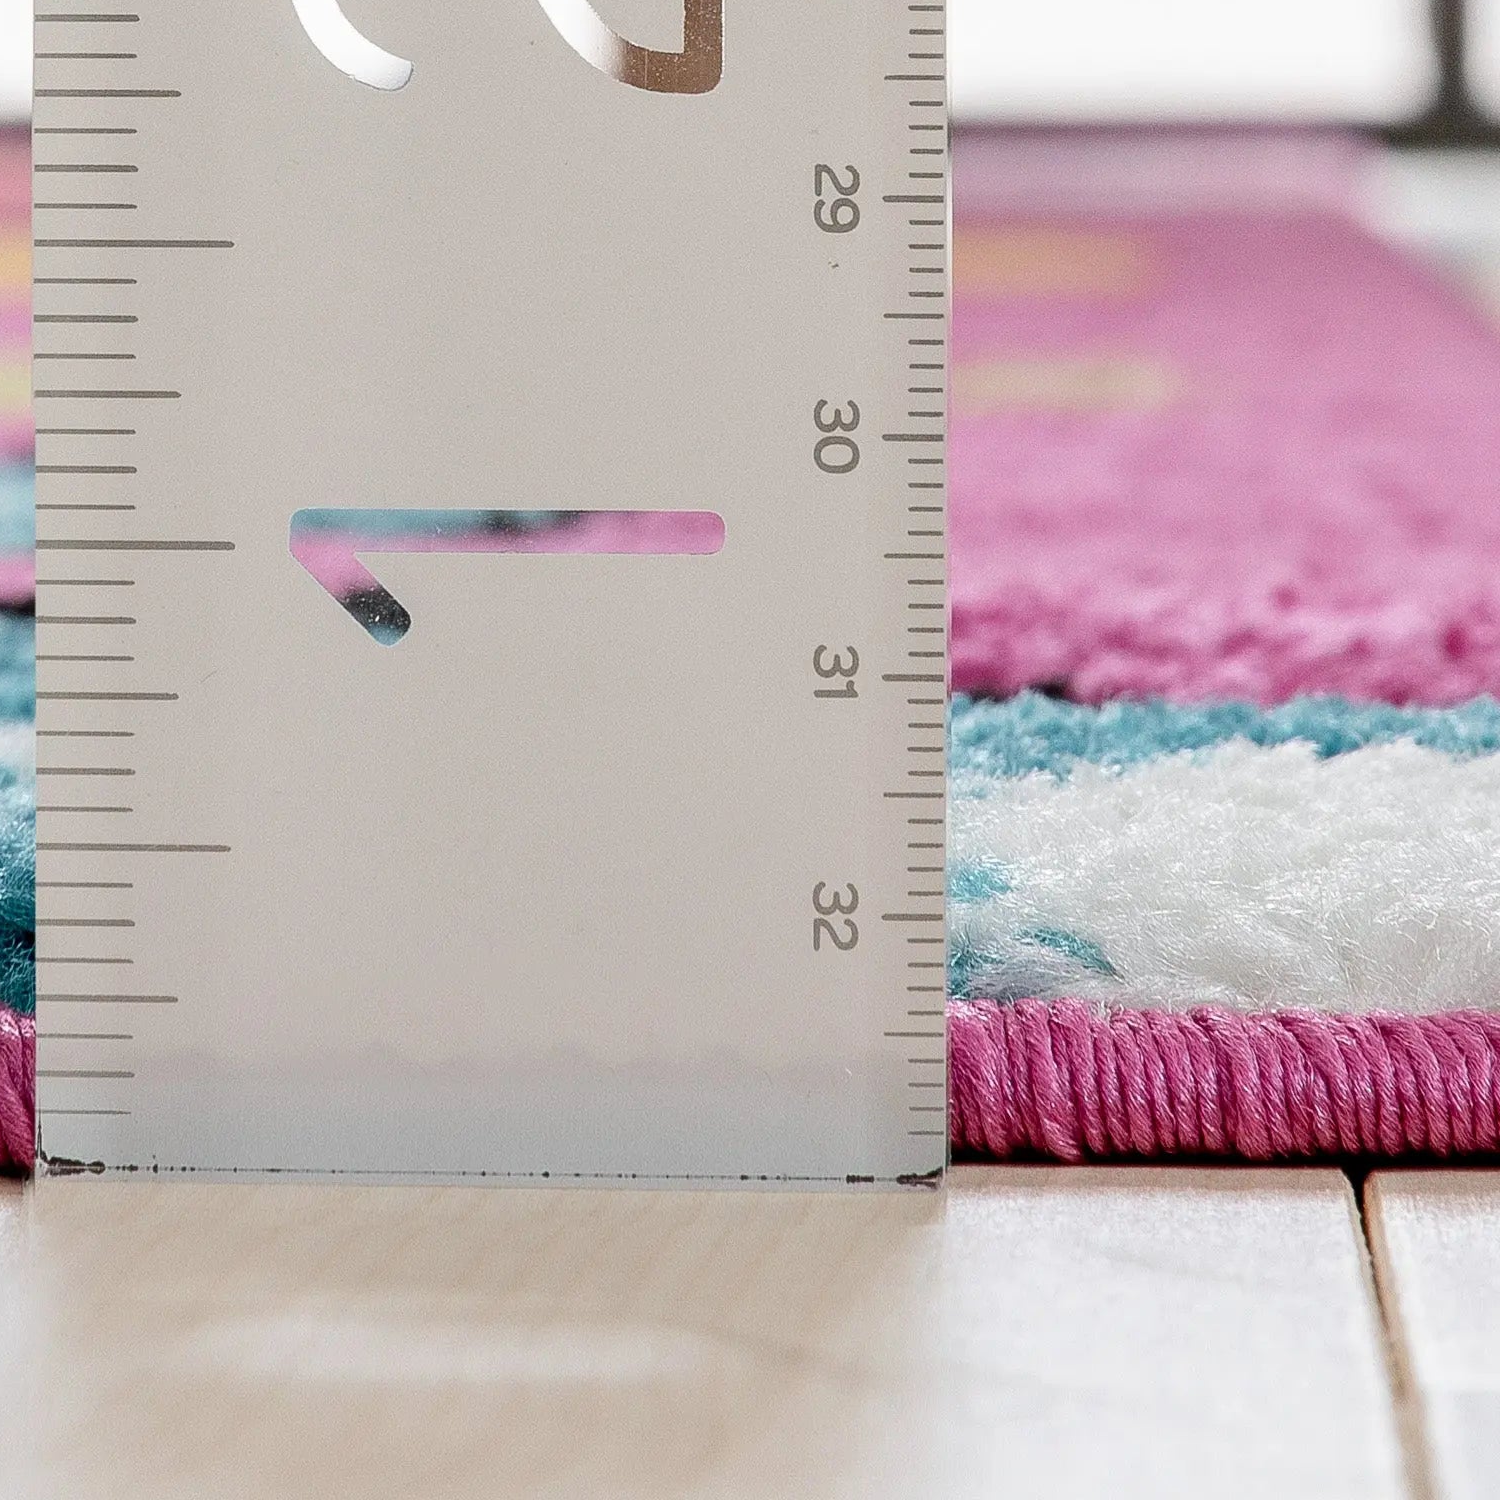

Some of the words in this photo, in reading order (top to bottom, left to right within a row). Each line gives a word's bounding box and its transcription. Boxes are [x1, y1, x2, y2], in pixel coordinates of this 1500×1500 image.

[813, 163, 861, 234] 29
[813, 398, 861, 475] 30
[289, 507, 726, 646] 1
[812, 644, 860, 700] 31
[812, 880, 859, 952] 32
